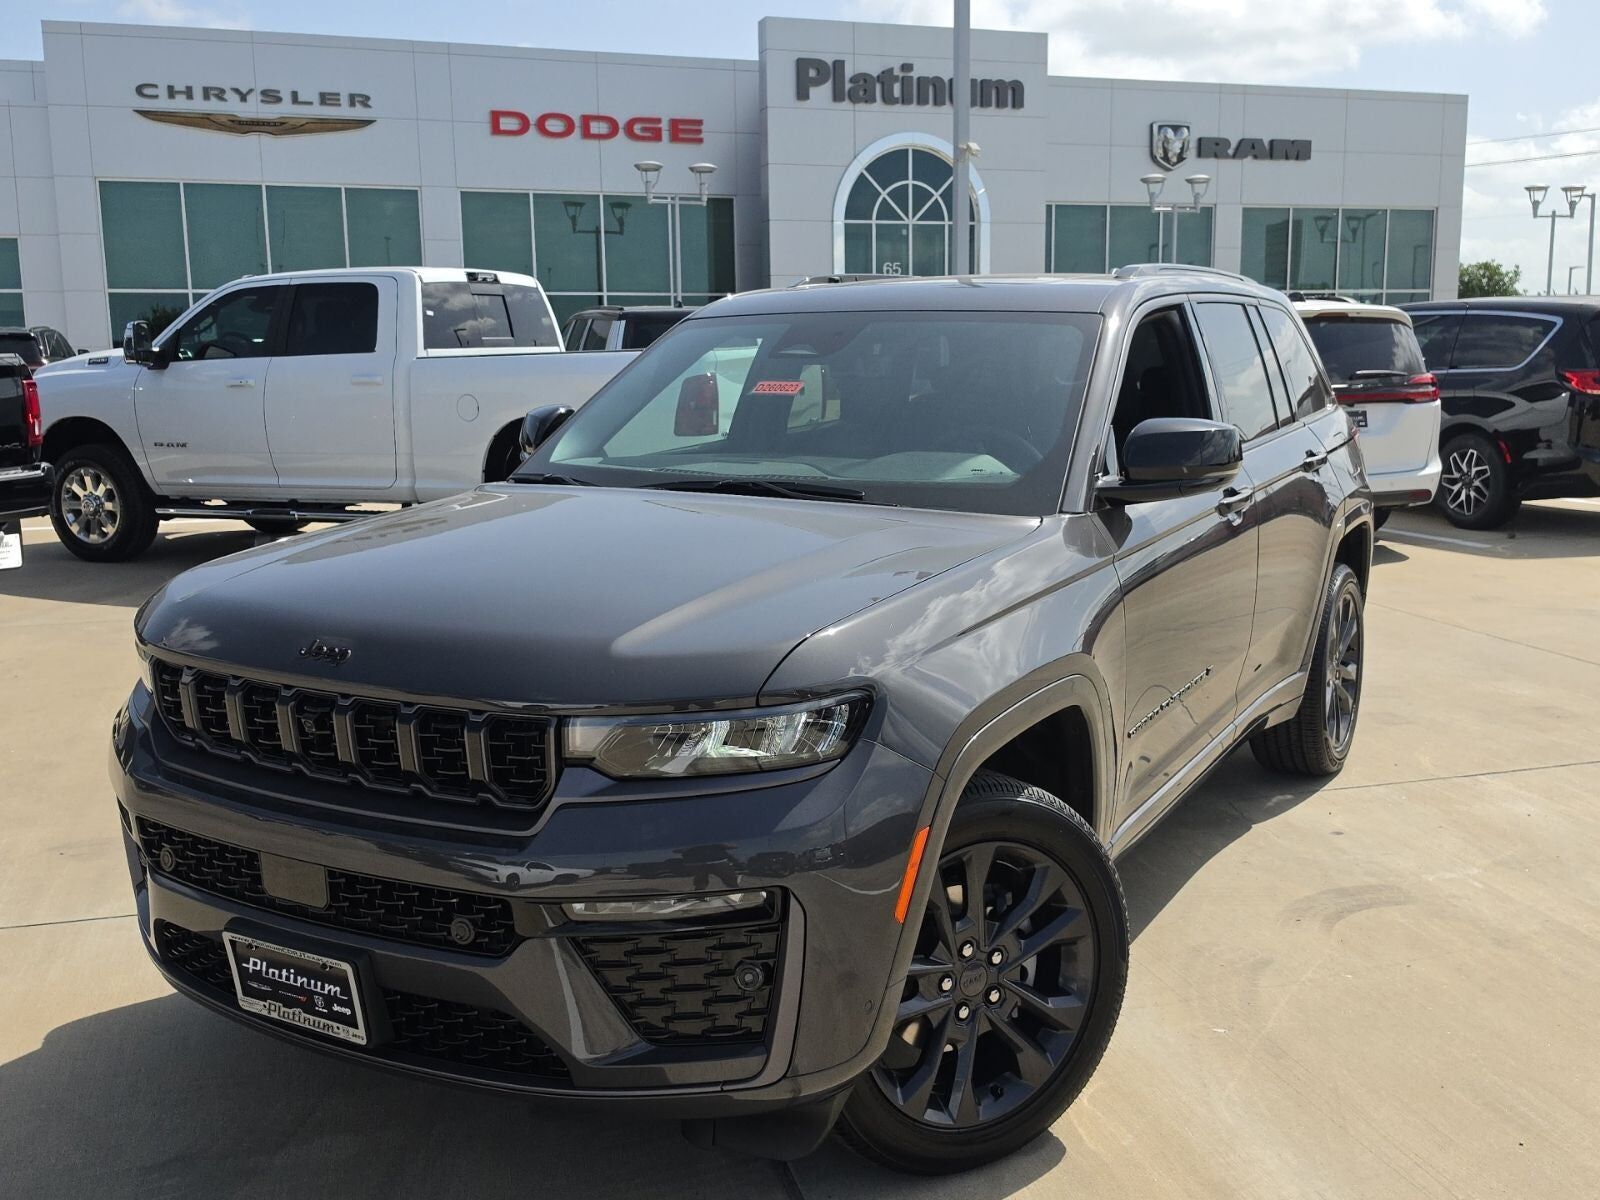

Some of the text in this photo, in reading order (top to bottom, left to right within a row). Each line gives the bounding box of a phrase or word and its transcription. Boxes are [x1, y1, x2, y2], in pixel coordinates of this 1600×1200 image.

[134, 83, 372, 109] CHRYSLER
[489, 110, 704, 144] DODGE
[1197, 137, 1312, 161] RAM
[882, 262, 902, 276] 65
[299, 638, 352, 666] Jeep
[242, 957, 348, 1000] Platinum
[267, 1001, 341, 1035] Platinum
[332, 1003, 352, 1016] Jeep
